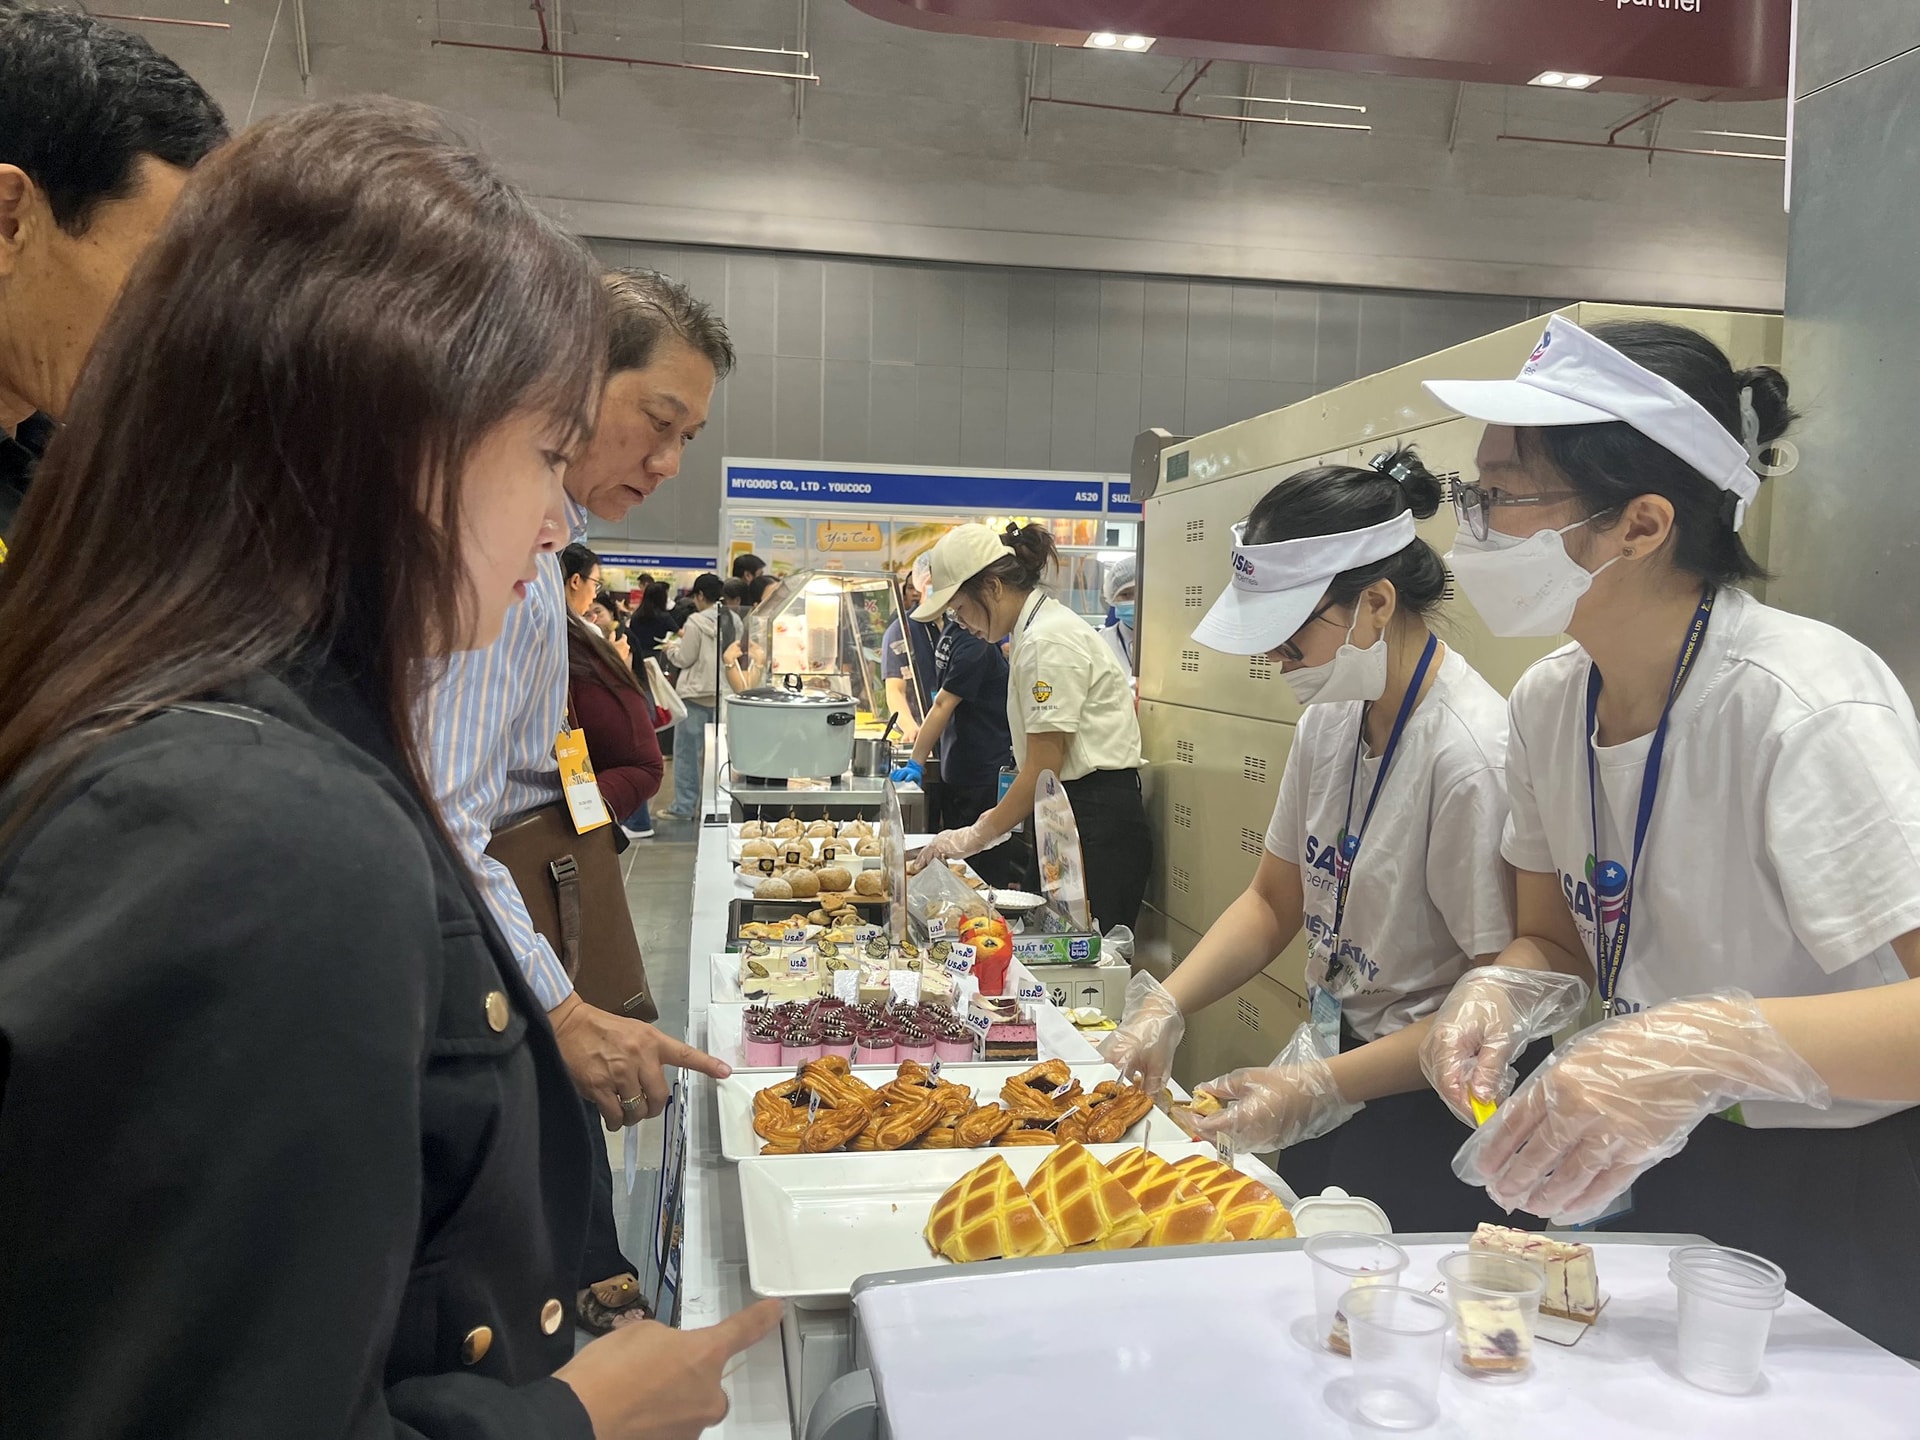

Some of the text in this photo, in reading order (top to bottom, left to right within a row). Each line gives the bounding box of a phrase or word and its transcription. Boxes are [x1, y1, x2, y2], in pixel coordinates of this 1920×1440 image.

[731, 478, 778, 490] MYGOODS
[801, 481, 820, 492] LTD
[828, 482, 872, 494] YOUCOCO
[1075, 492, 1099, 502] A520
[1694, 620, 1703, 631] LTD
[1306, 835, 1336, 877] SA
[1558, 868, 1594, 922] SA
[1071, 948, 1088, 957] blue
[947, 959, 962, 971] USA
[1019, 988, 1037, 998] USA
[967, 1013, 984, 1029] USA
